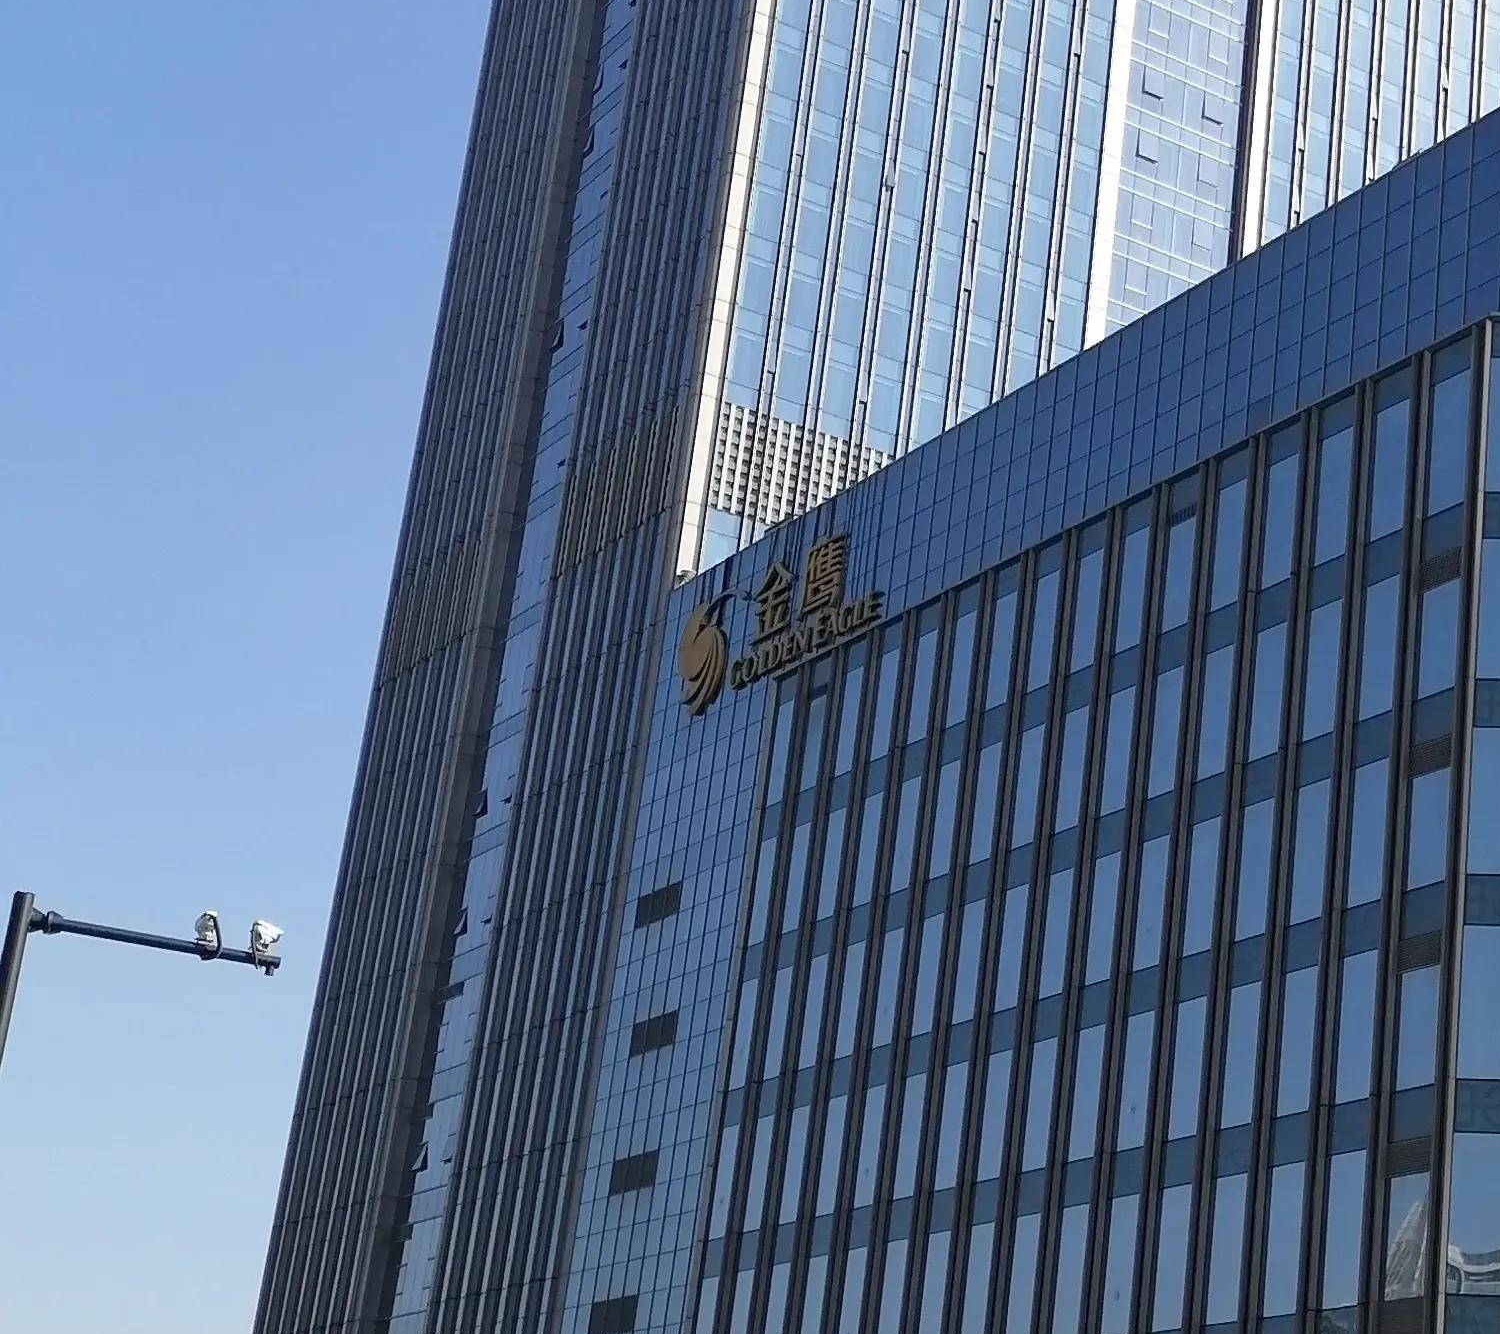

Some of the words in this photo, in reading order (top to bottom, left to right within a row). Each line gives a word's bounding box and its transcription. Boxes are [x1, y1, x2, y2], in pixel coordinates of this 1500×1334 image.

[729, 621, 815, 691] GOLDEN
[813, 590, 886, 651] EAGLE
[750, 533, 848, 645] 金鹰
